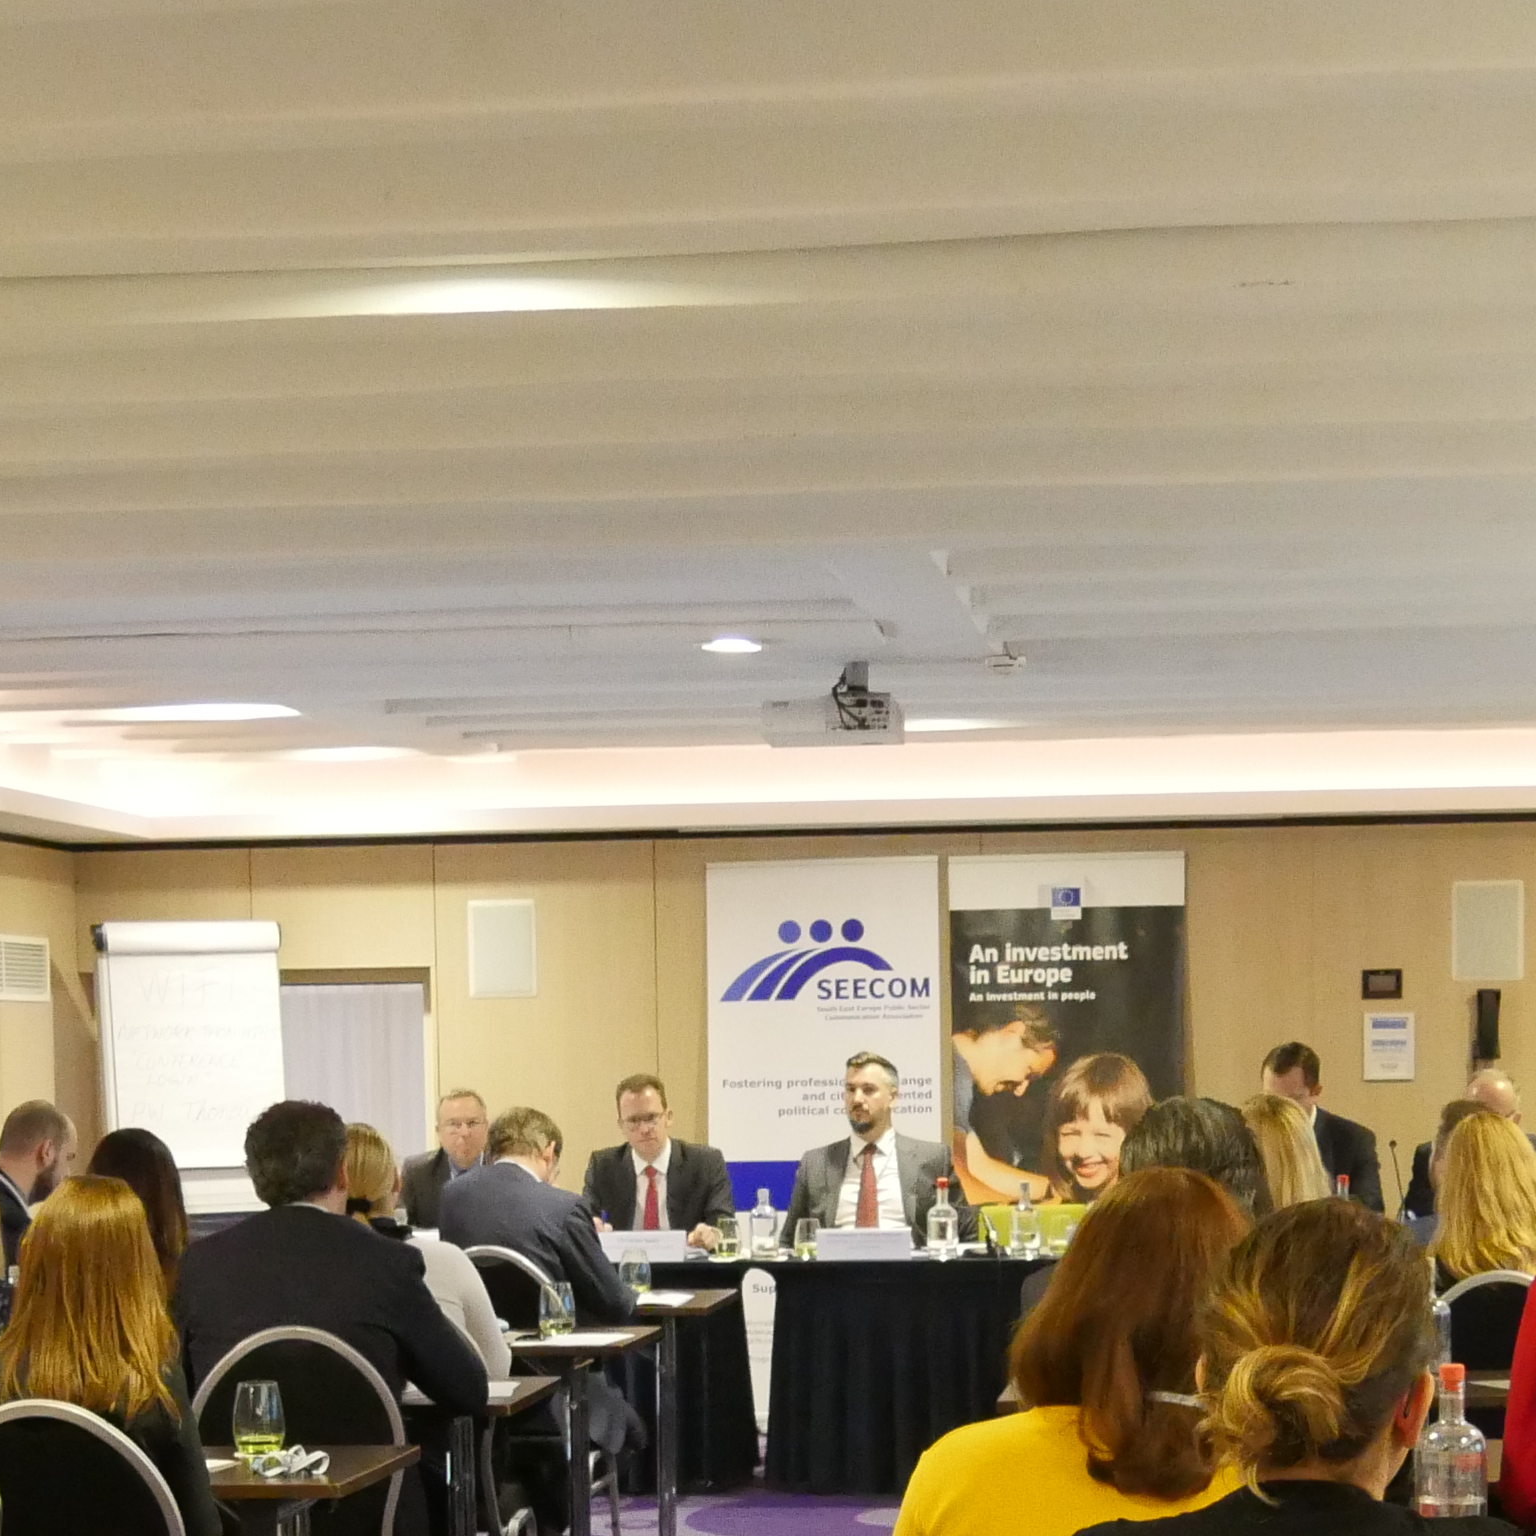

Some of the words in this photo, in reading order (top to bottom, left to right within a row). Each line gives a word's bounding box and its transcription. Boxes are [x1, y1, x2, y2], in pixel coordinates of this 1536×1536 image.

[969, 943, 998, 963] An
[1005, 942, 1128, 961] investment
[969, 965, 990, 984] in
[996, 964, 1073, 987] Europe
[817, 977, 930, 1000] SEECOM
[969, 993, 984, 1002] An
[986, 992, 1045, 1001] investment
[1048, 991, 1059, 1001] in
[1061, 990, 1096, 1003] people
[722, 1077, 782, 1090] Fostering
[802, 1091, 826, 1101] and
[778, 1105, 829, 1118] political
